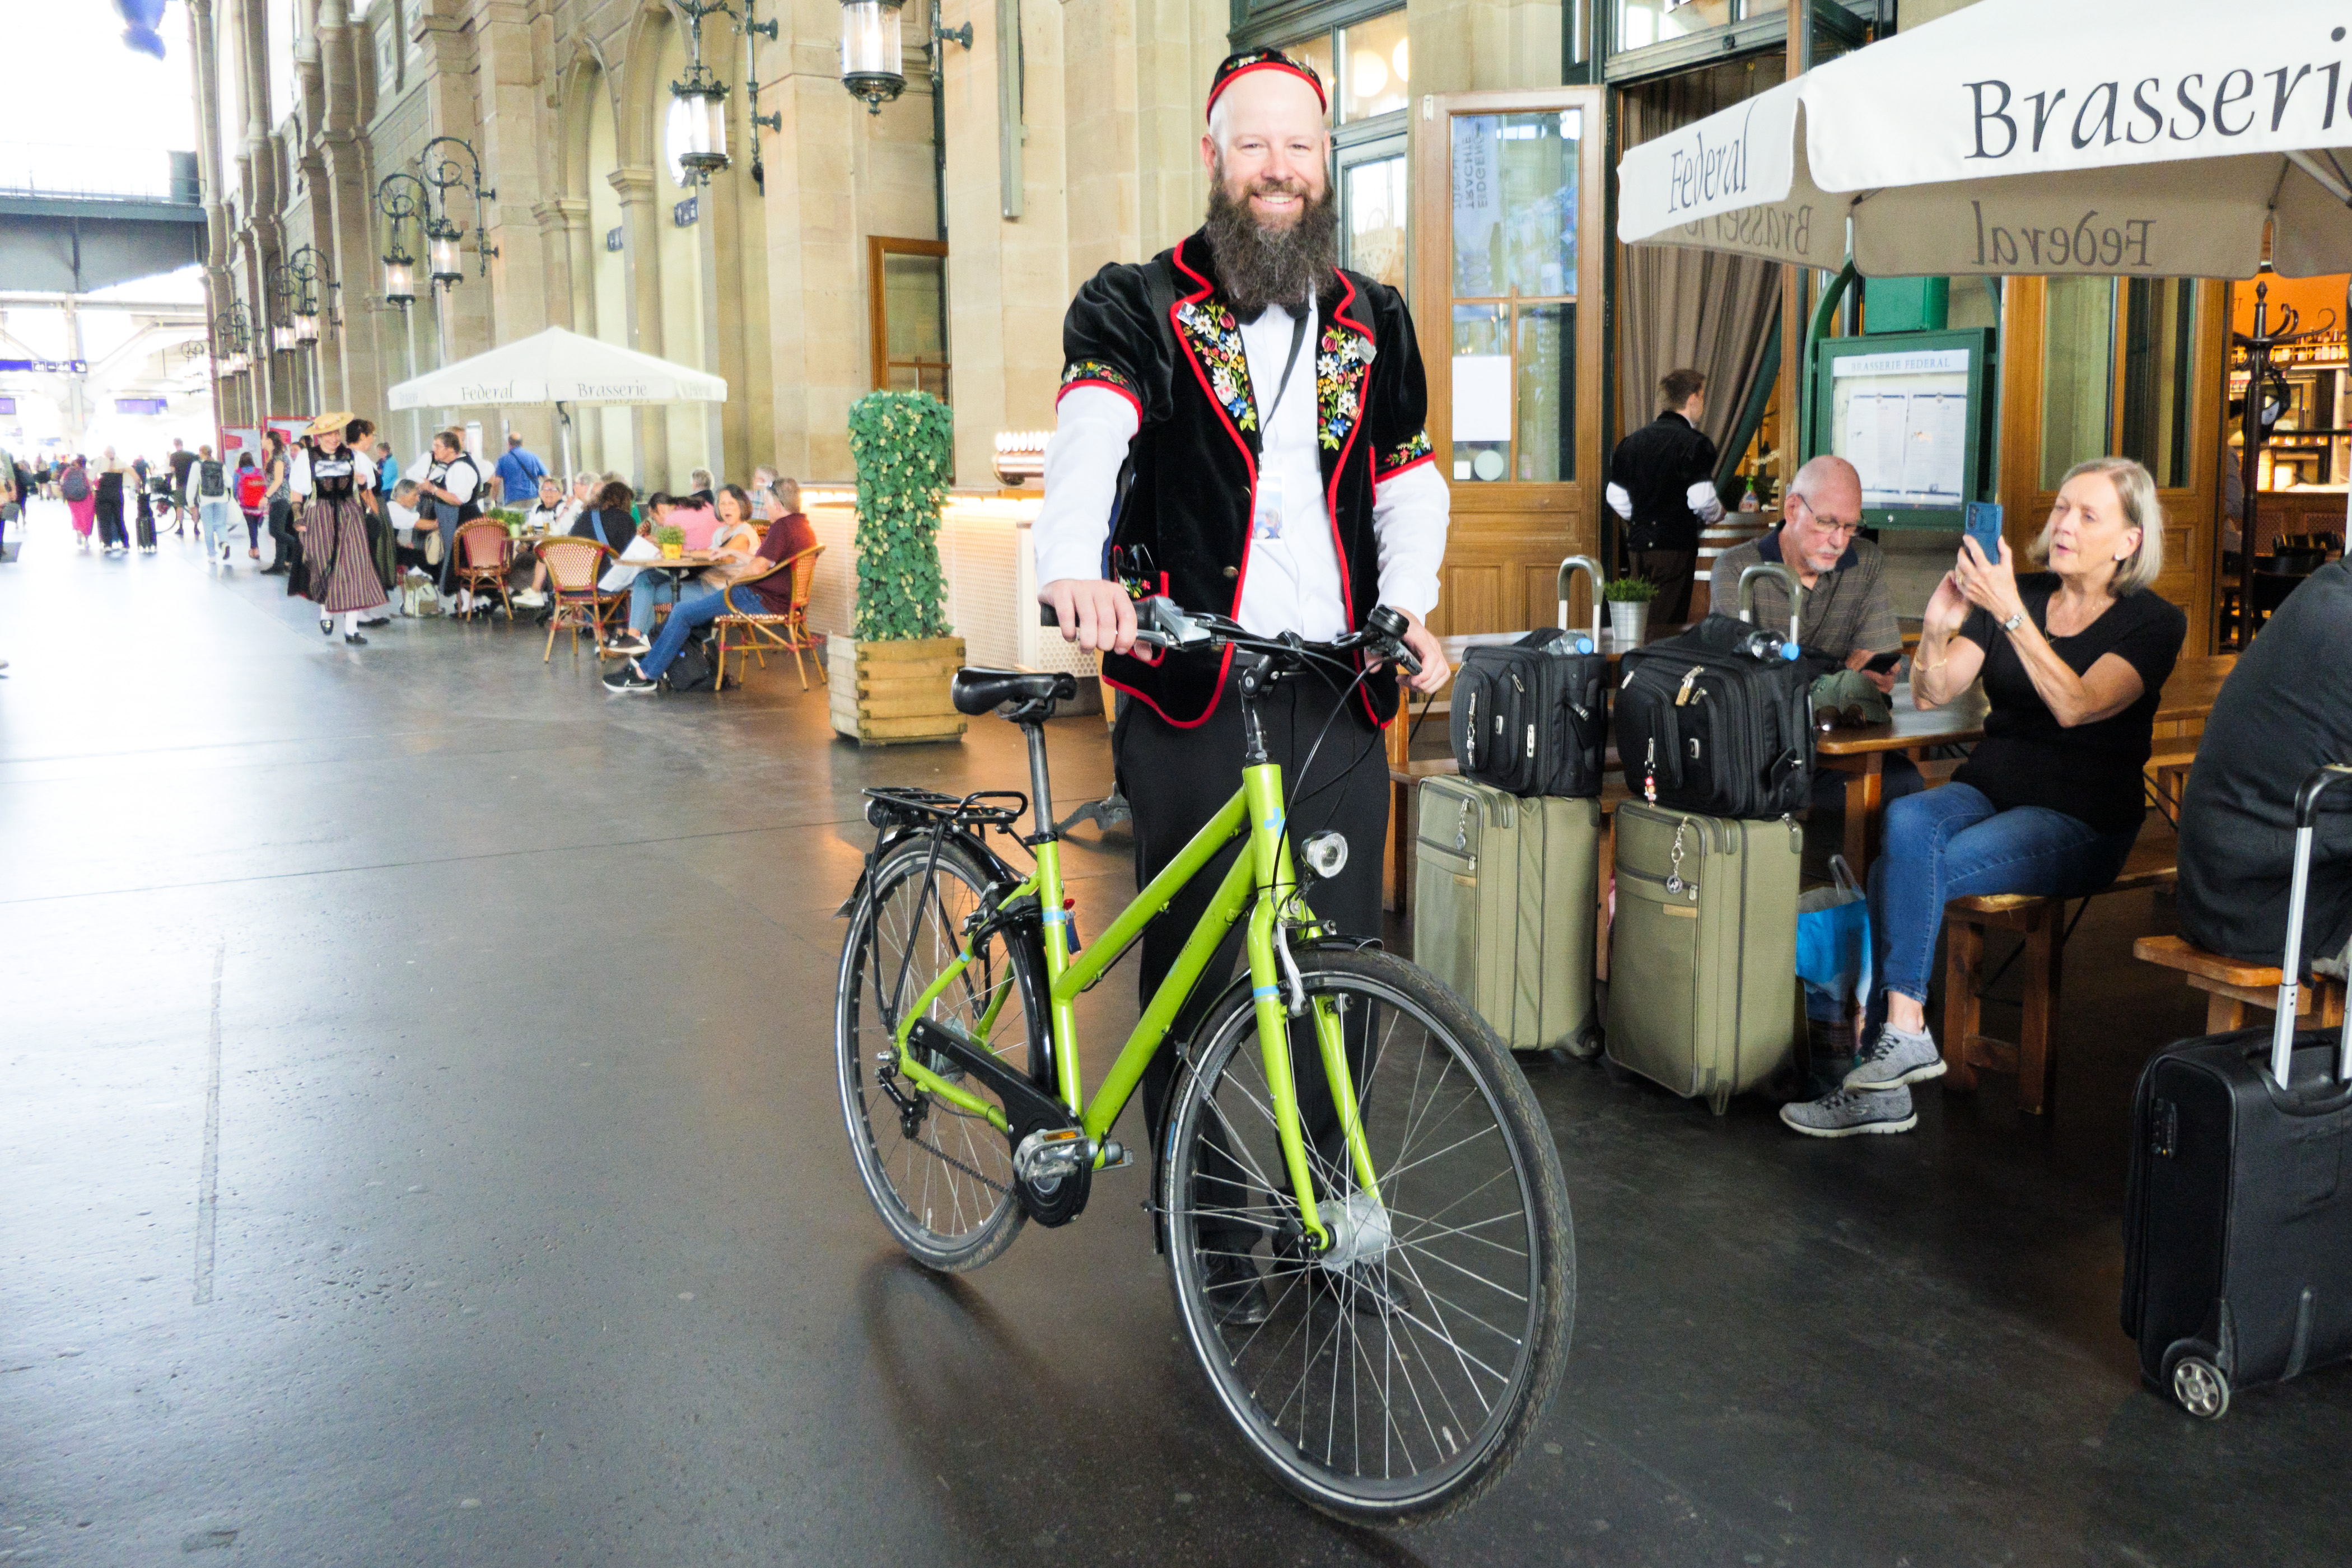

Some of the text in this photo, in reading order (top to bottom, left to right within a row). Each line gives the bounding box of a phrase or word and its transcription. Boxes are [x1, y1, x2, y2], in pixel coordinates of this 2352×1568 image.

[1962, 26, 2352, 159] Brasseri
[1668, 97, 1760, 214] Federal
[1851, 358, 1950, 372] BRASSERIE FEDERAL
[461, 380, 514, 400] Federal
[577, 380, 647, 398] Brasserie
